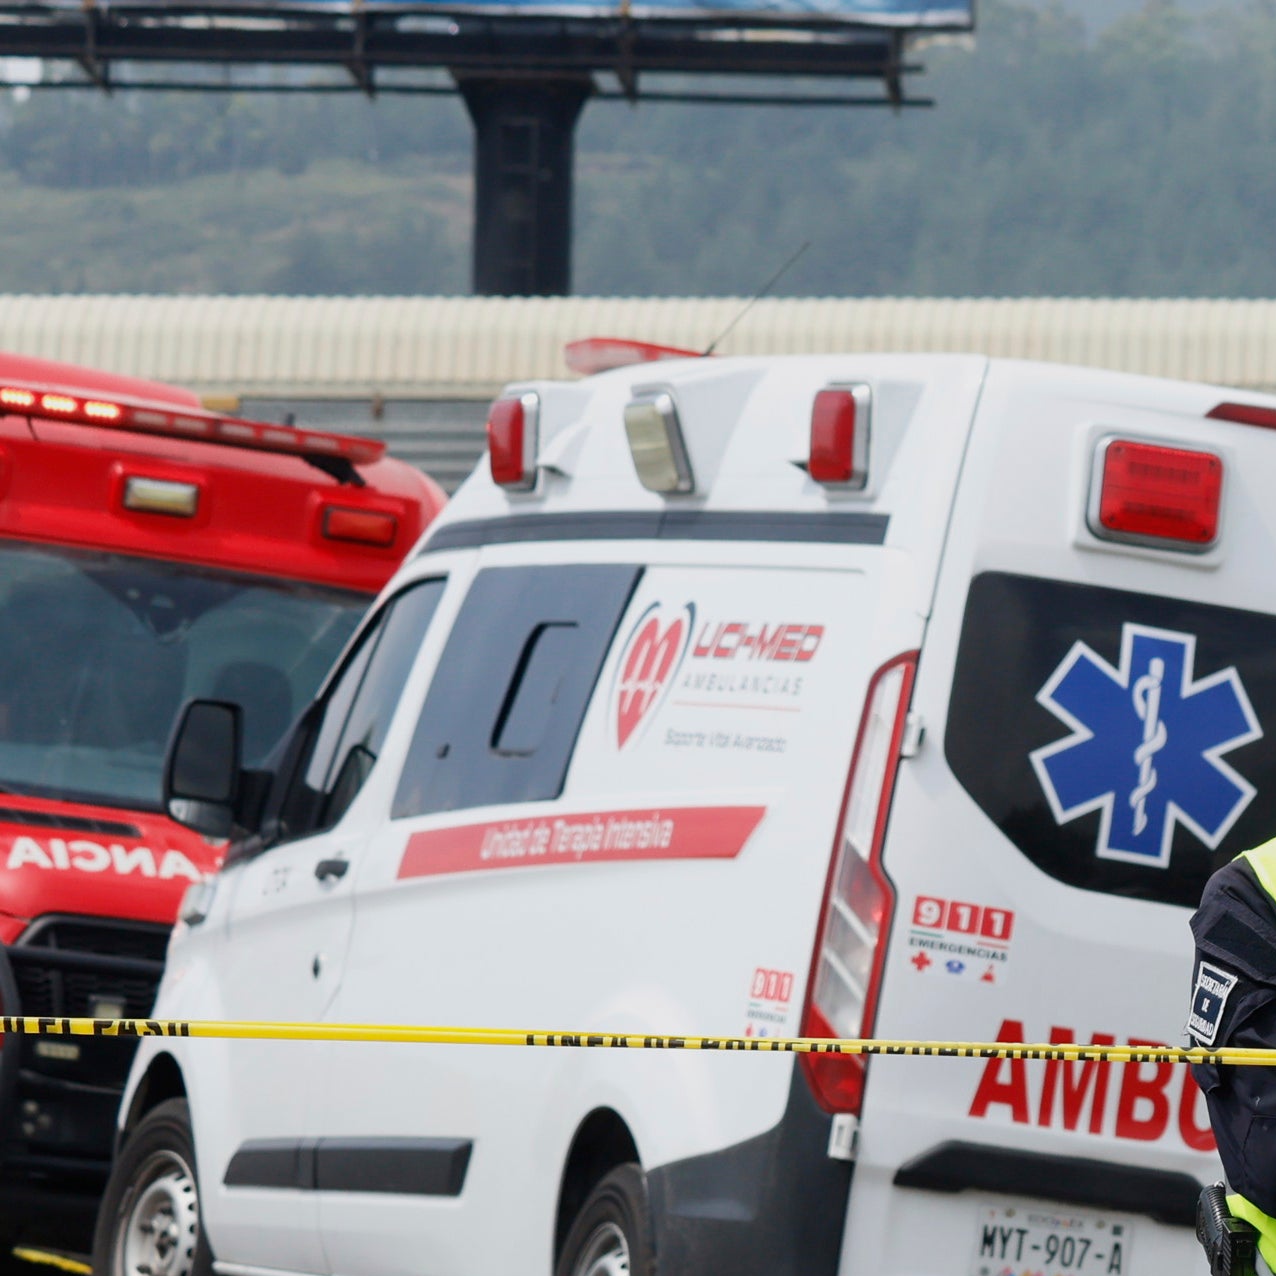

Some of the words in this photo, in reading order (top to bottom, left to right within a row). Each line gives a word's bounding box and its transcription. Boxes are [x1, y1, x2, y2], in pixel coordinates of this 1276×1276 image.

[915, 898, 1010, 939] 911
[908, 937, 1008, 963] EMERGENCIAS
[980, 1224, 1123, 1276] MYT-907-A
